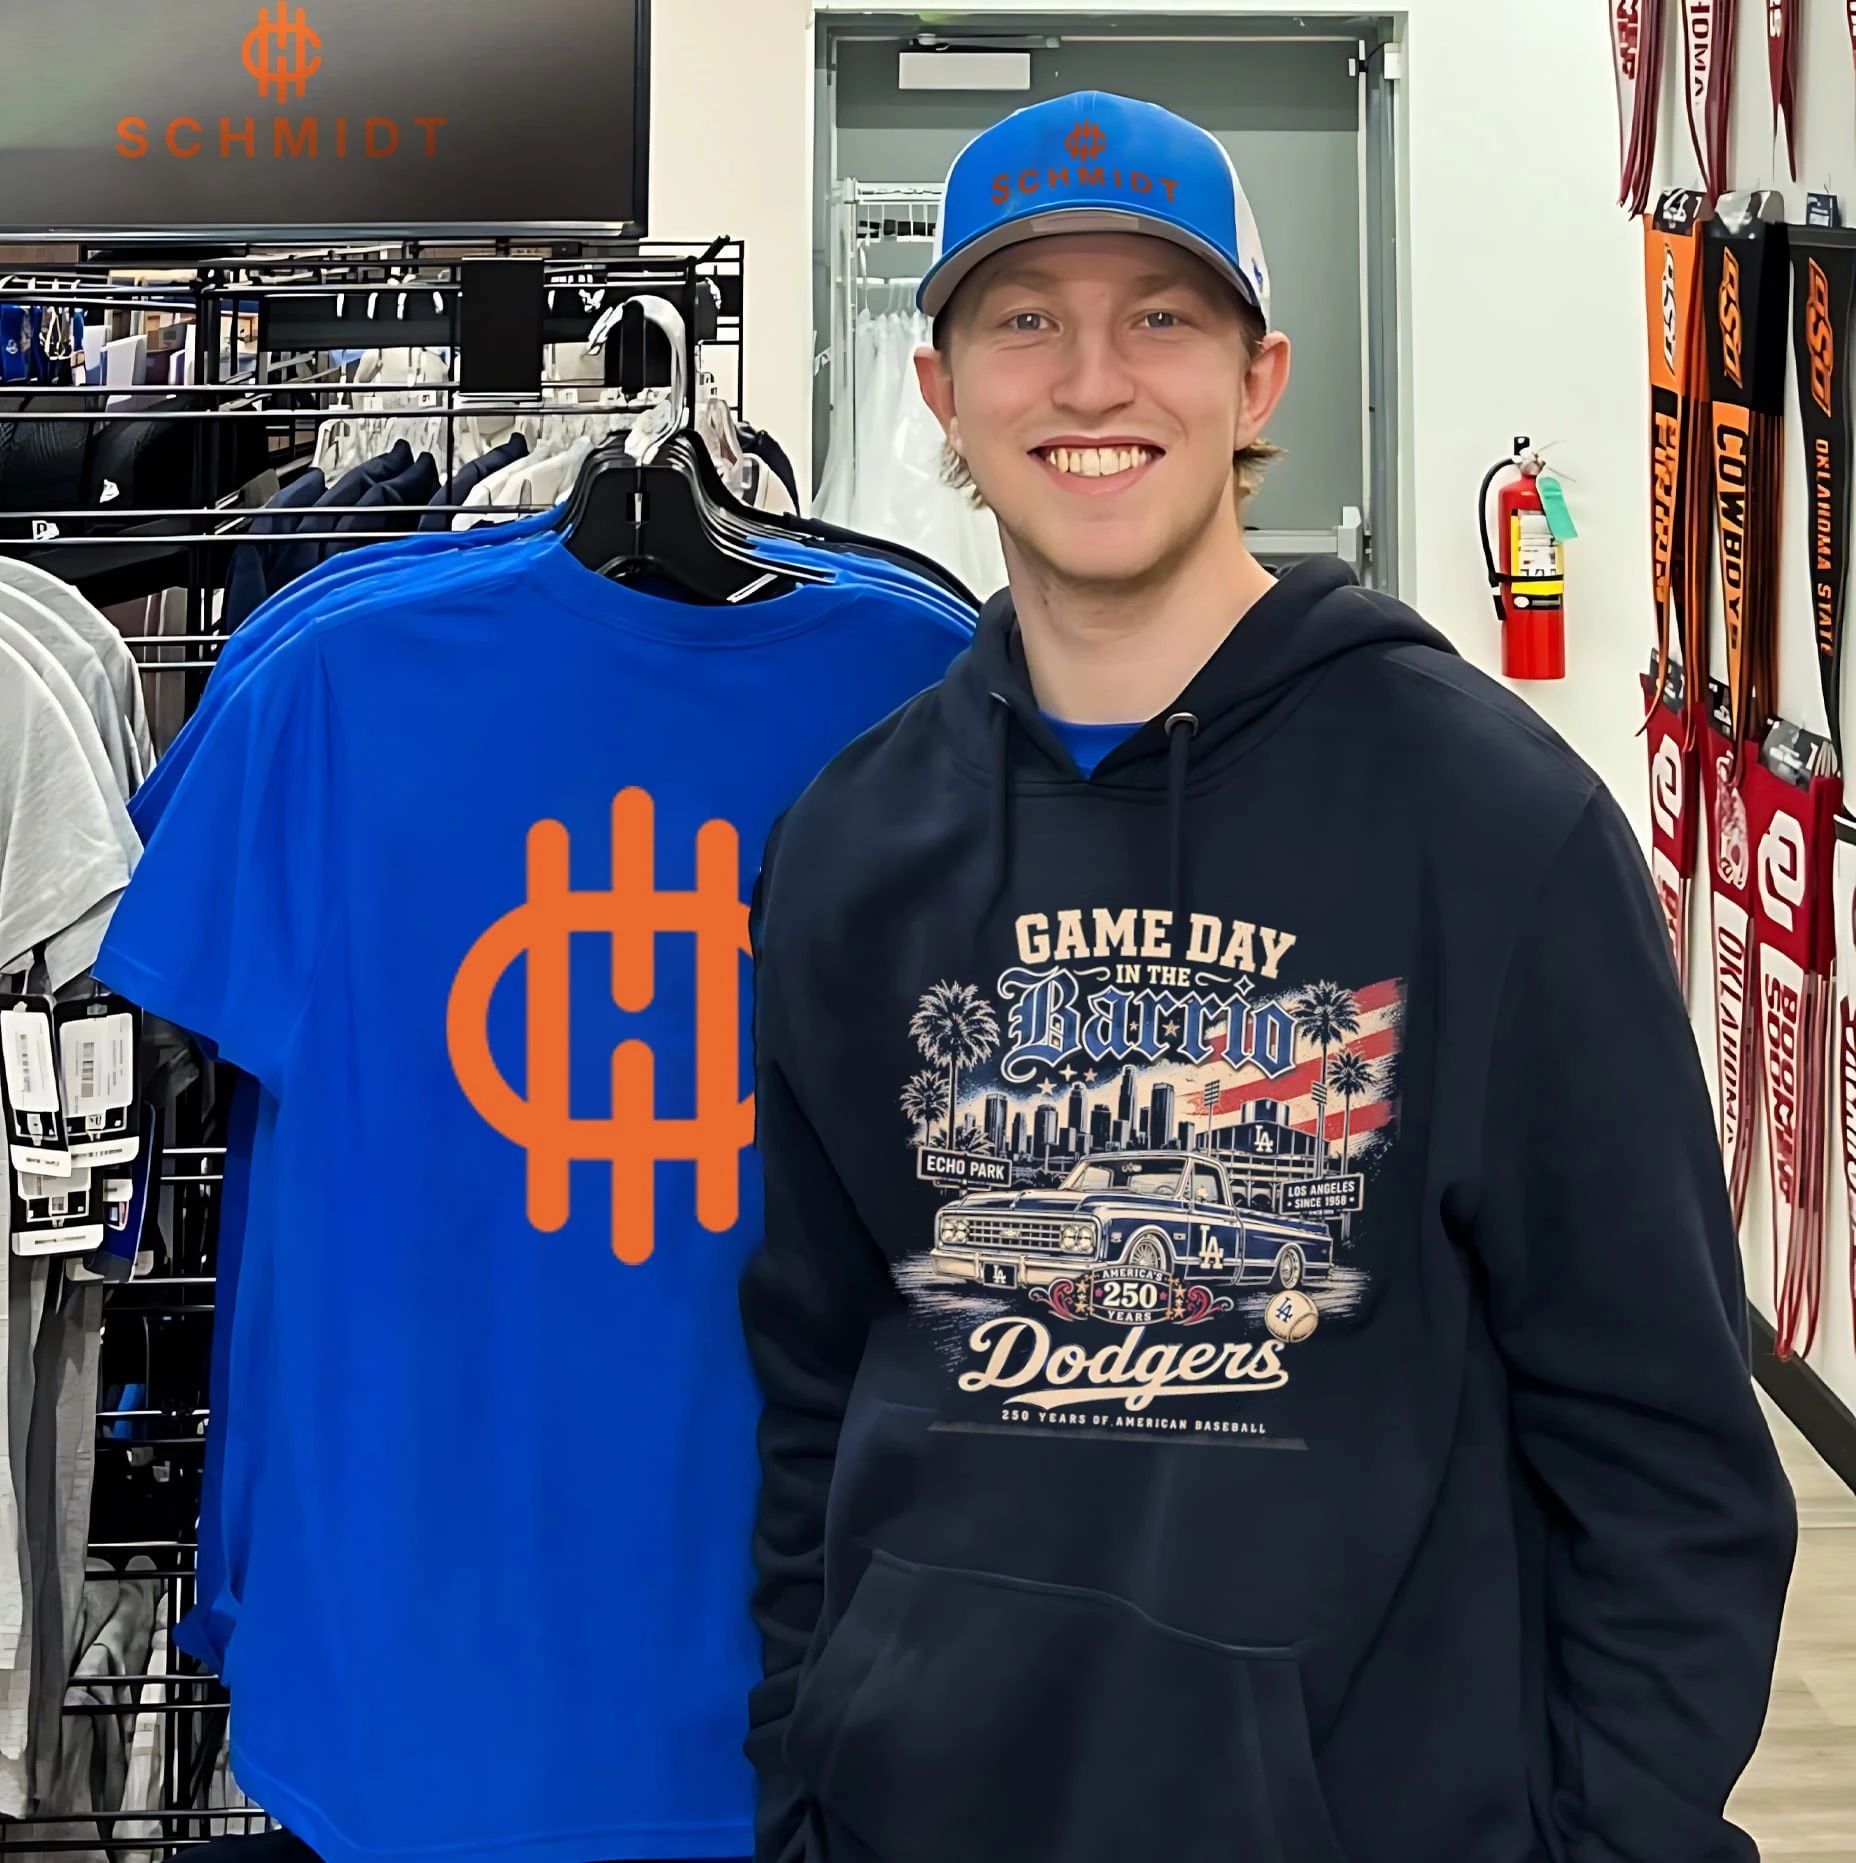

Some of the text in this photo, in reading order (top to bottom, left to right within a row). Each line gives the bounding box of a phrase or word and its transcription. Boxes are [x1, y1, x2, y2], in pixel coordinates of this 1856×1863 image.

[116, 117, 447, 158] SCHMIDT
[991, 167, 1180, 204] SCHMIDT
[1815, 438, 1832, 570] OKLAHOMA
[1015, 908, 1296, 979] GAME DAY
[1116, 964, 1191, 987] IN THE
[997, 965, 1298, 1083] Barrio
[1717, 926, 1743, 1144] OKLAHOMA
[1254, 1125, 1274, 1153] LA
[926, 1155, 1005, 1180] ECHO PARK
[1288, 1181, 1355, 1197] LOS ANGELES
[1294, 1195, 1347, 1208] SINCE 1958
[1199, 1225, 1224, 1269] LA
[992, 1265, 1006, 1284] LA
[1102, 1269, 1163, 1281] AMERICA'S
[1102, 1282, 1158, 1308] 250
[1107, 1310, 1151, 1321] YEARS
[958, 1316, 1289, 1411] Dodgers
[1002, 1409, 1266, 1434] 250 YEARS OF AMERICAN BASEBALL
